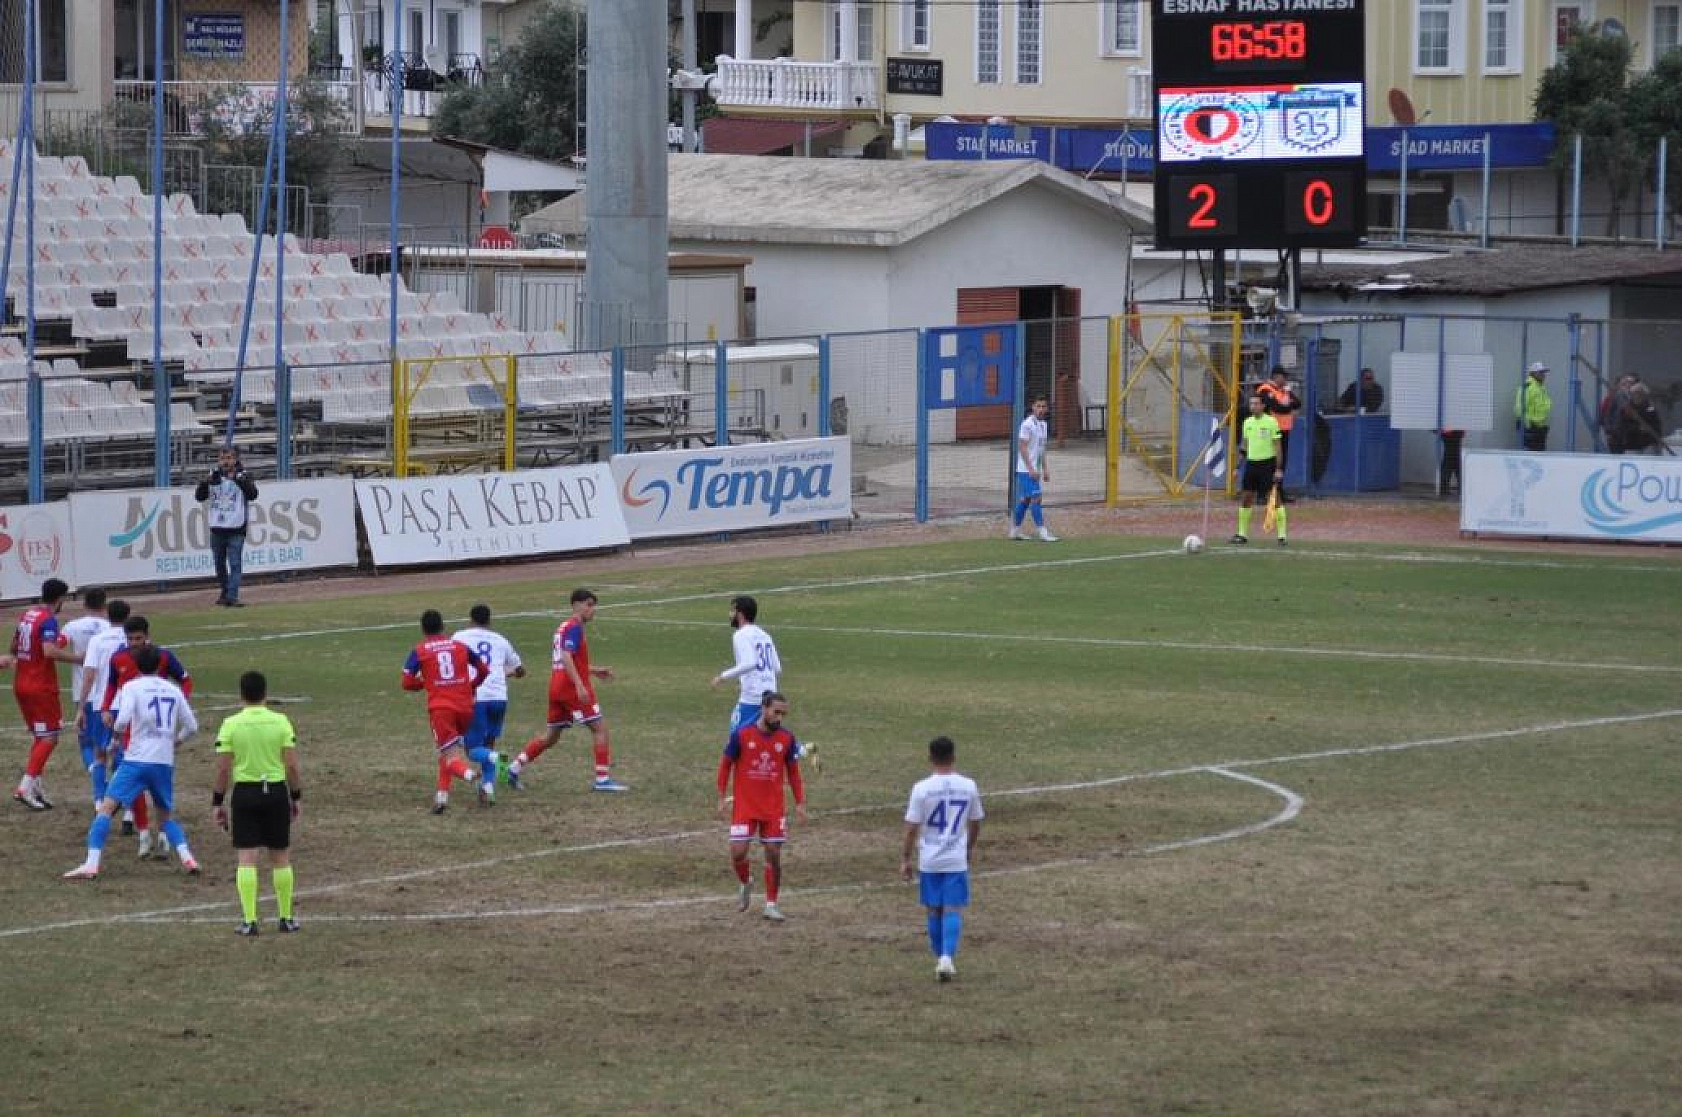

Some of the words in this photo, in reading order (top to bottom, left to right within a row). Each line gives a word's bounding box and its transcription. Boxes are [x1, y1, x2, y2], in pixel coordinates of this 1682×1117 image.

[1212, 22, 1306, 61] 66:58
[989, 139, 1037, 154] MARKET
[1391, 140, 1428, 156] SAD
[1187, 183, 1219, 229] 2
[1303, 179, 1334, 226] 0
[676, 457, 834, 517] Tempa
[109, 493, 323, 561] Addess
[370, 485, 472, 548] PAŞA
[478, 475, 598, 528] KEBAP
[280, 546, 303, 562] BAR
[436, 650, 455, 680] 8
[755, 642, 774, 672] 30
[148, 695, 176, 730] 17
[927, 799, 969, 835] 47
